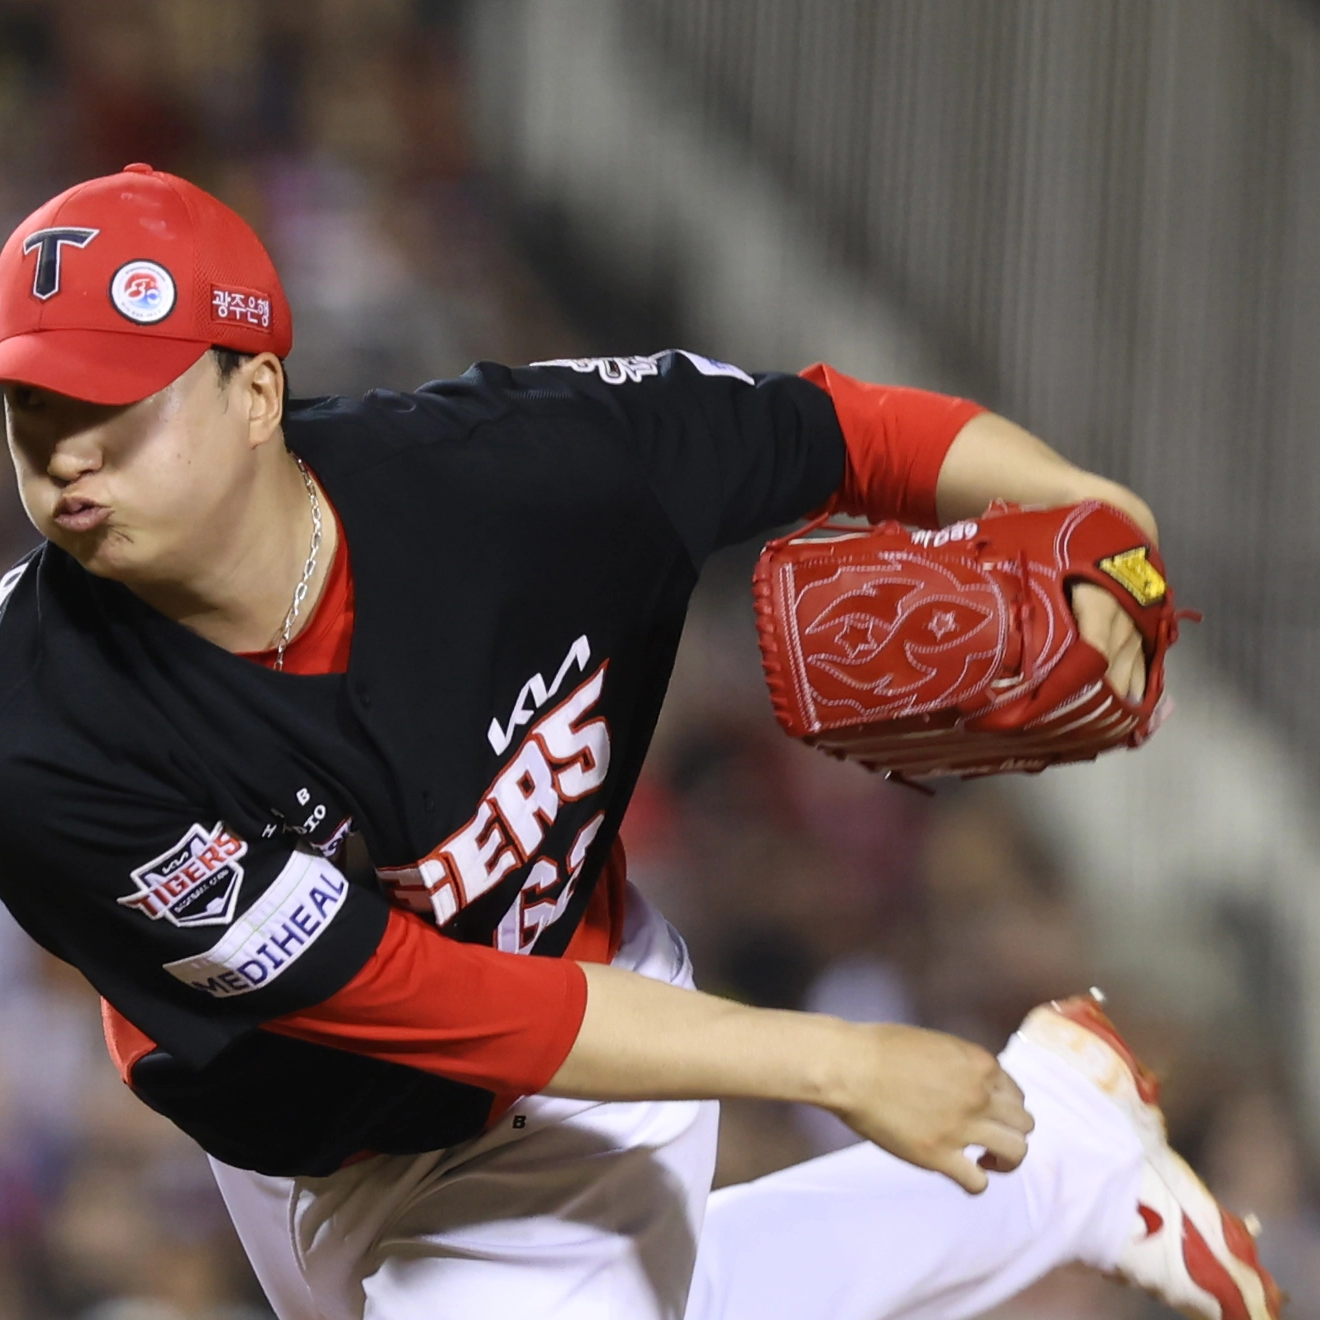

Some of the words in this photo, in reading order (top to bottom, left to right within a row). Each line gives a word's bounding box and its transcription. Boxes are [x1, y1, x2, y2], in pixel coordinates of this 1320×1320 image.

[23, 227, 100, 300] T
[212, 290, 270, 328] 광주은행
[123, 828, 244, 917] TIGERS
[191, 873, 345, 994] MEDIHEAL
